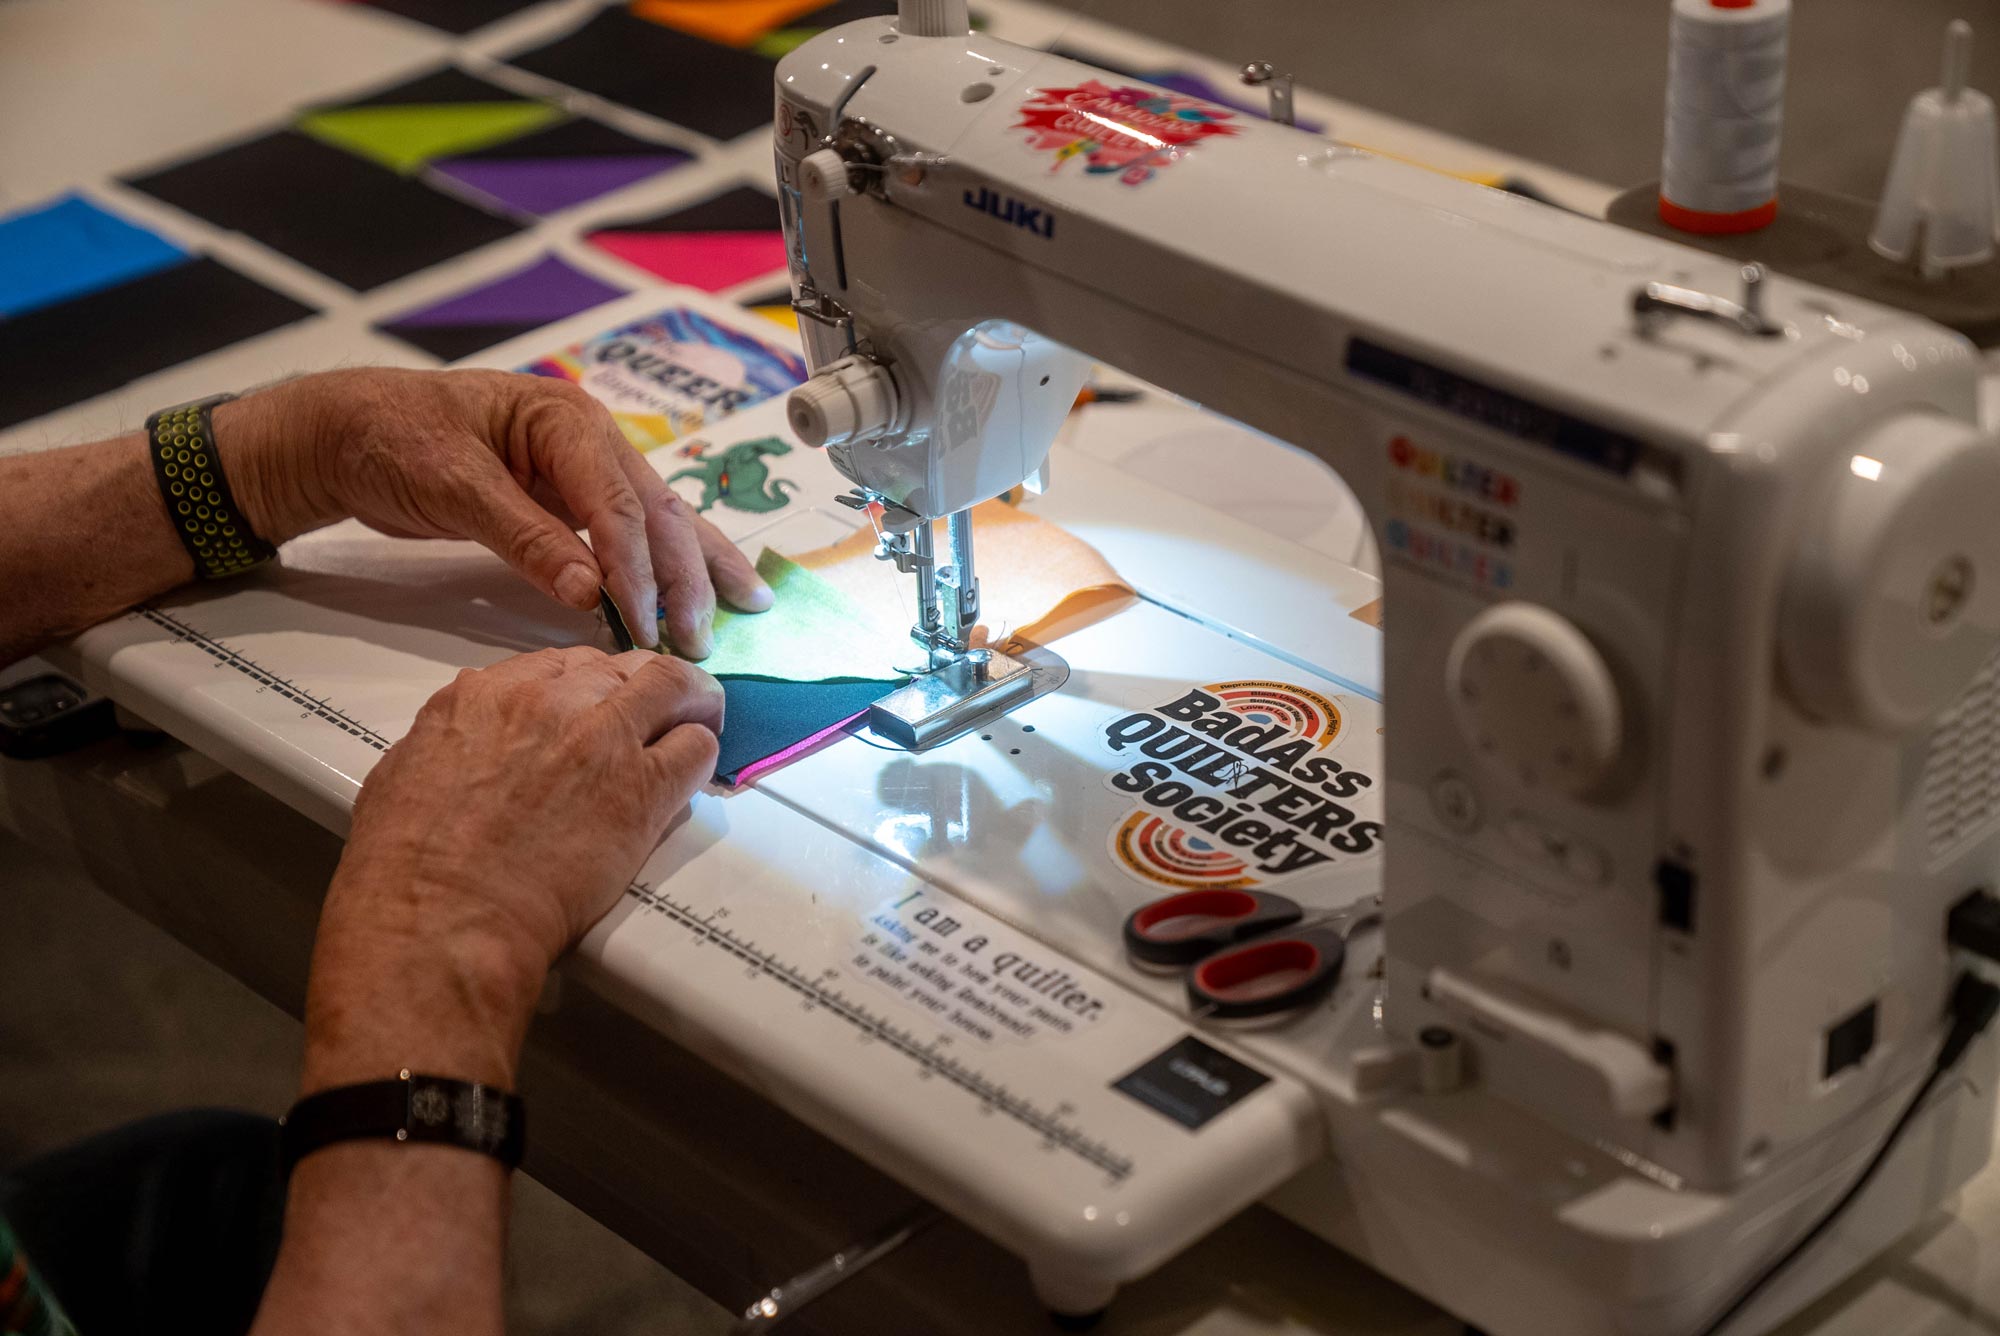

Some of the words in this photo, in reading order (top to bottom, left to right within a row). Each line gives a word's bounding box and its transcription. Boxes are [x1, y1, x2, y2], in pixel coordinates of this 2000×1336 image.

[963, 187, 1055, 238] JUKI
[595, 340, 750, 412] QUEER
[1220, 681, 1283, 690] Reproductive
[1284, 684, 1311, 697] Rights
[1250, 699, 1286, 708] Science
[1274, 709, 1288, 721] Love
[1105, 713, 1384, 853] QUILTERS
[893, 890, 923, 909] I
[914, 908, 961, 937] am
[962, 934, 988, 954] a
